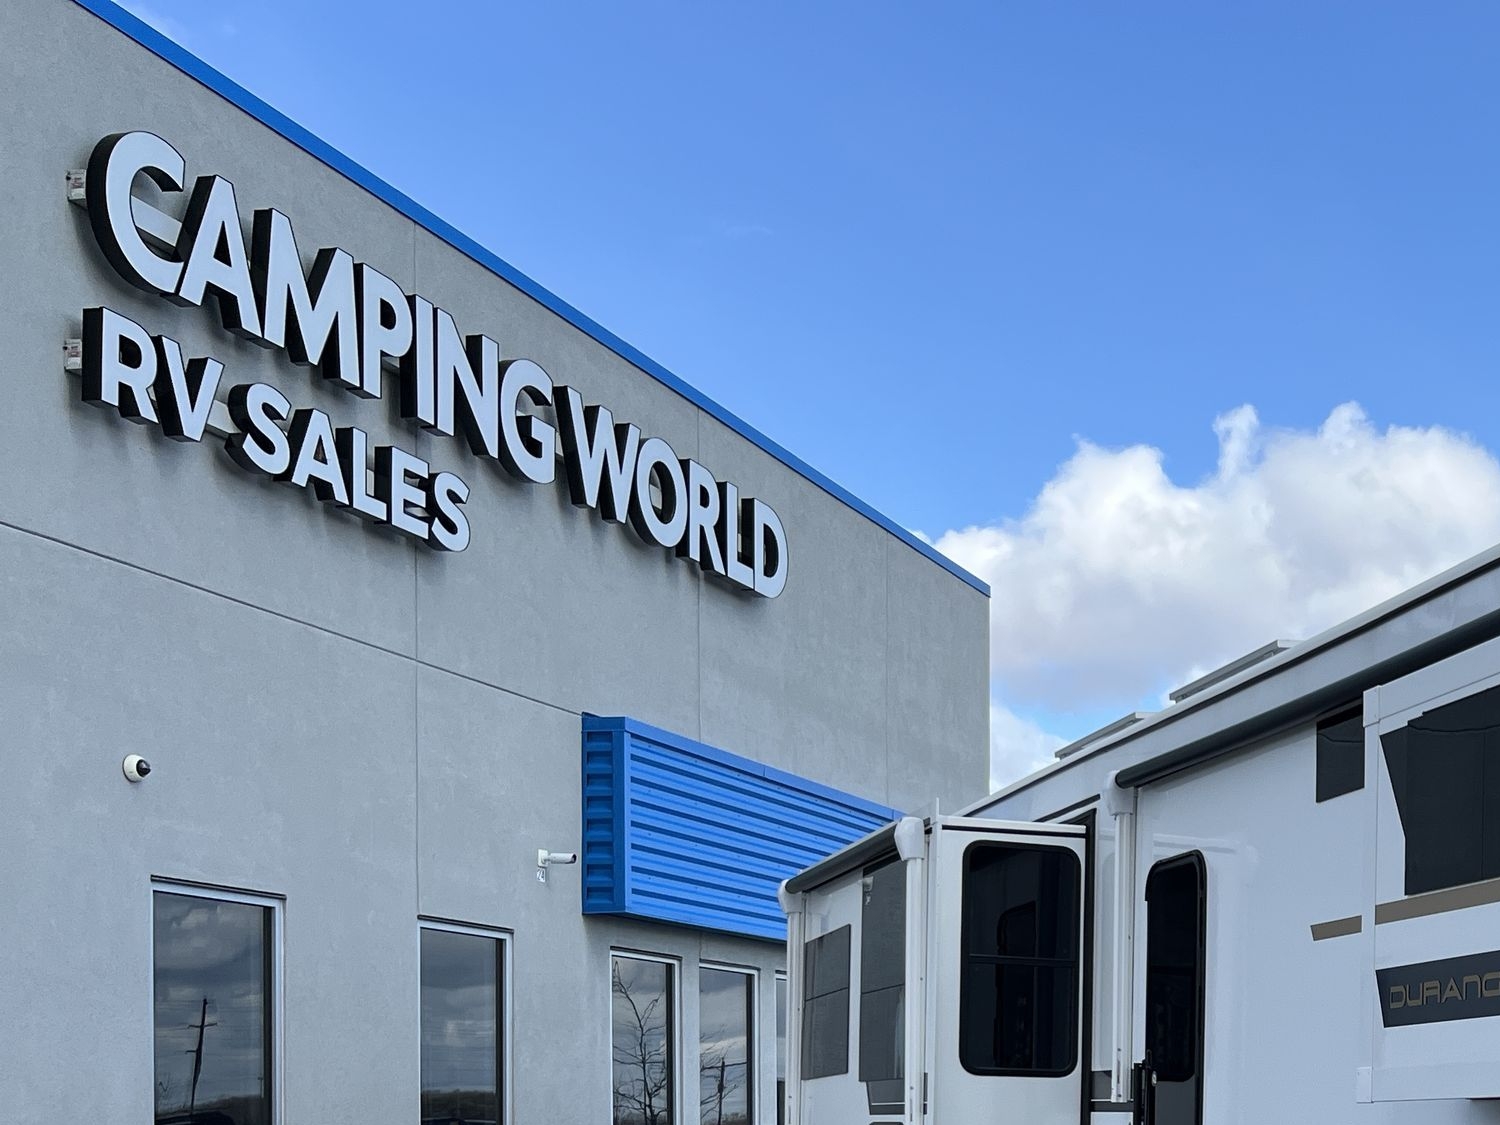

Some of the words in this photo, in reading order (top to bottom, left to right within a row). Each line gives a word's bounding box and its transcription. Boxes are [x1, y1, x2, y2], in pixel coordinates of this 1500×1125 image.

[83, 306, 223, 443] RV
[226, 383, 471, 552] SALES
[88, 131, 556, 485] CAMPING
[555, 386, 789, 599] WORLD
